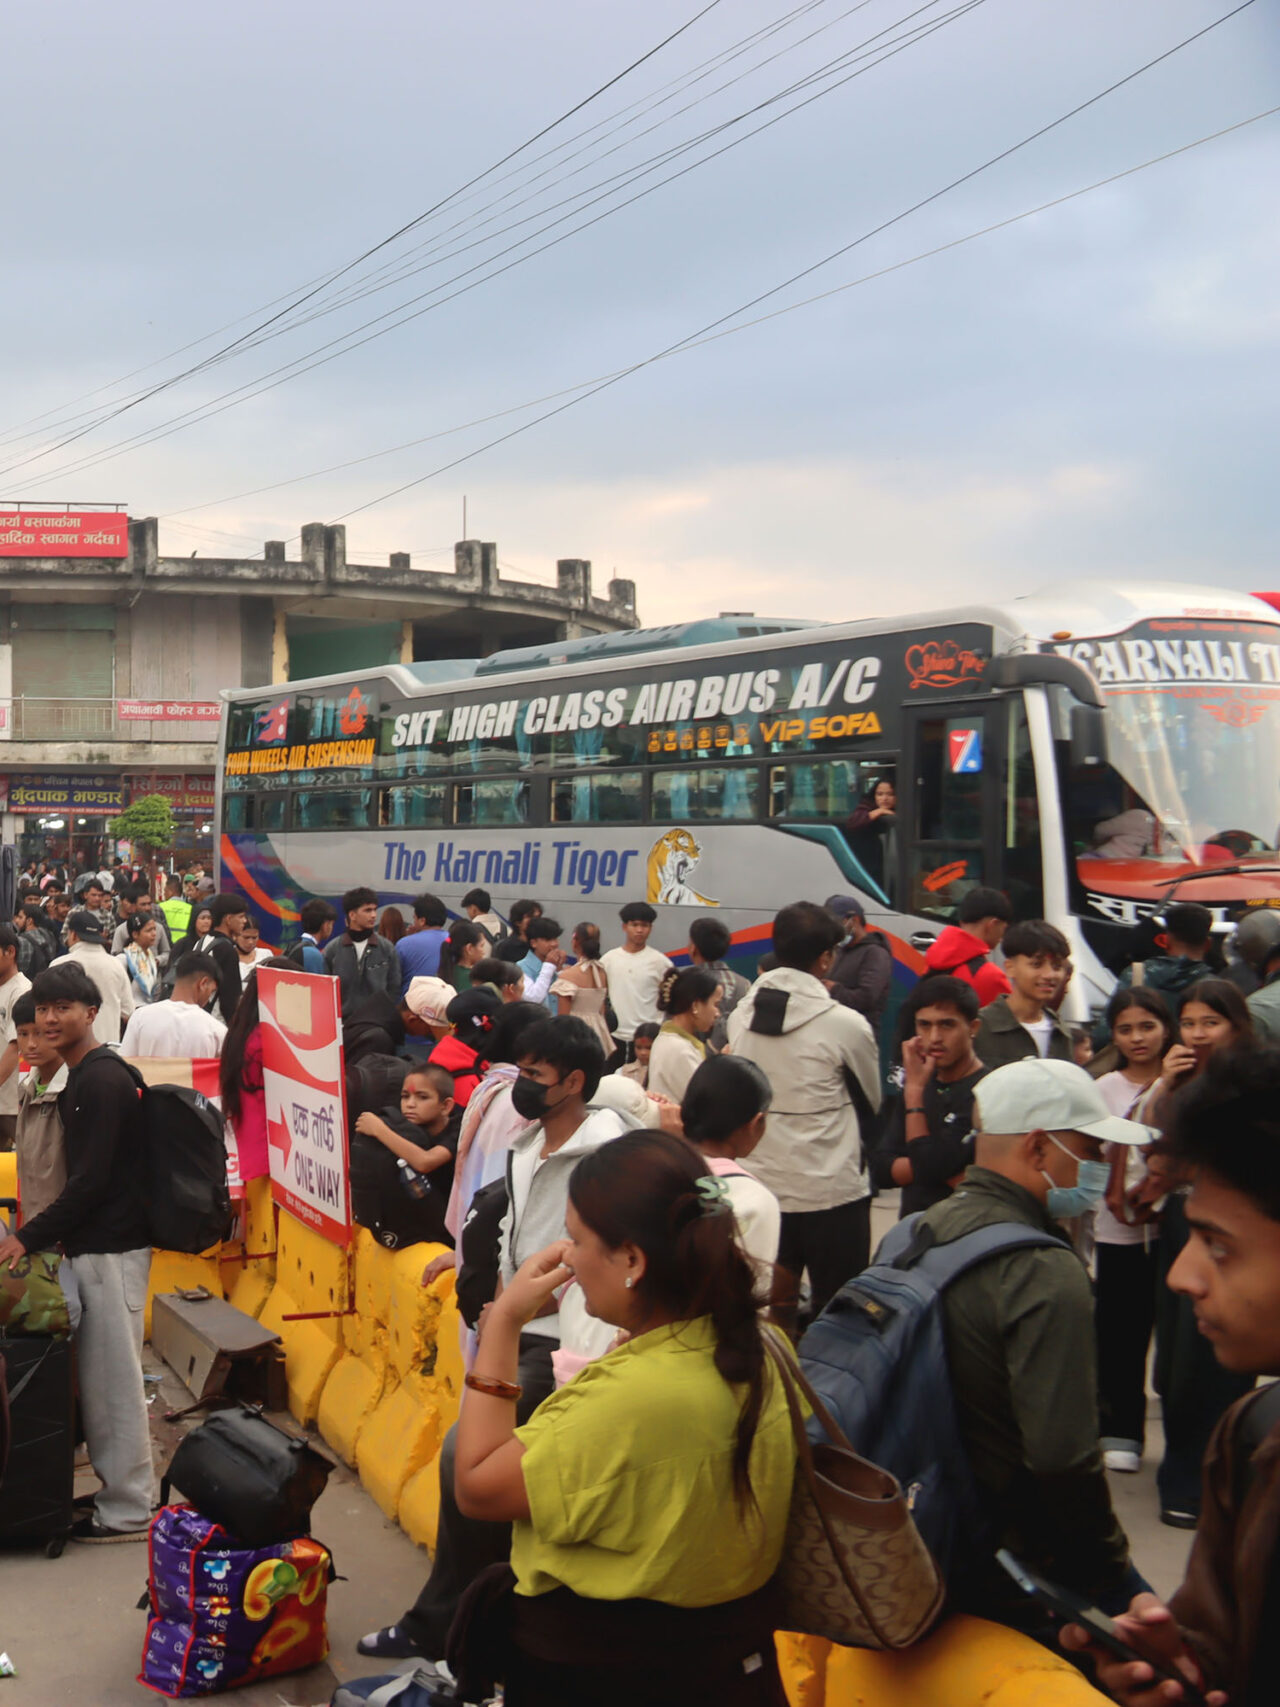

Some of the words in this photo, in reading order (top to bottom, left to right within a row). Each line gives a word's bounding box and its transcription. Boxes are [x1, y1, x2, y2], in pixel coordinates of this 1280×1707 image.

[392, 708, 443, 747] SKT
[447, 700, 519, 743] HIGH
[523, 688, 627, 735] CLASS
[629, 669, 781, 726] AIRBUS
[788, 656, 882, 711] A/C
[759, 720, 805, 744] VIP
[806, 711, 883, 741] SOFA
[226, 751, 250, 776] FOUR
[250, 747, 288, 775] WHEELS
[287, 745, 307, 771] AIR
[306, 738, 376, 769] SUSPENSION
[384, 842, 426, 881] The
[433, 842, 541, 885] Karnali
[552, 841, 639, 894] Tiger
[292, 1102, 309, 1138] एक
[294, 1151, 315, 1195] ONE
[315, 1161, 340, 1208] WAY
